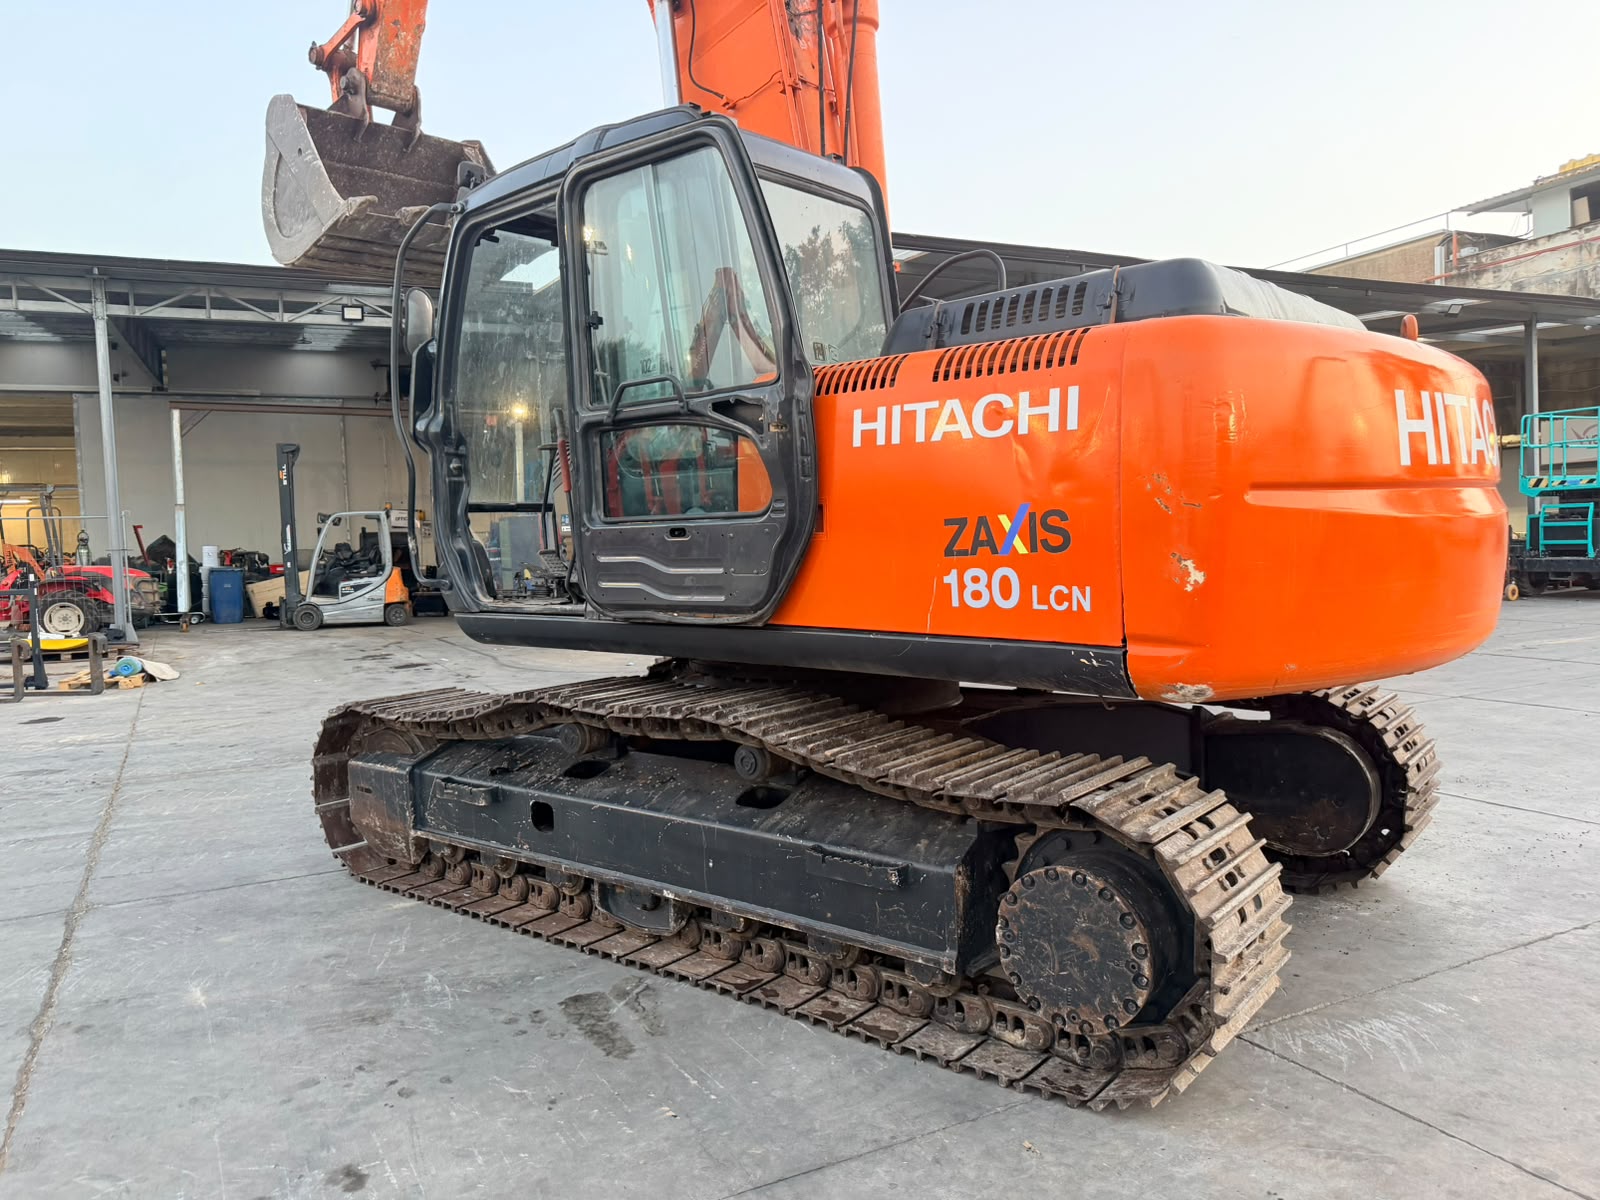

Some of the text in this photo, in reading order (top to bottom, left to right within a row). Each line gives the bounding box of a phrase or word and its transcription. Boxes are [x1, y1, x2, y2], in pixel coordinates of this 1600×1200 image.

[852, 385, 1080, 448] HITACHI
[943, 502, 1072, 557] ZAXIS
[943, 567, 1091, 612] 180 LCN
